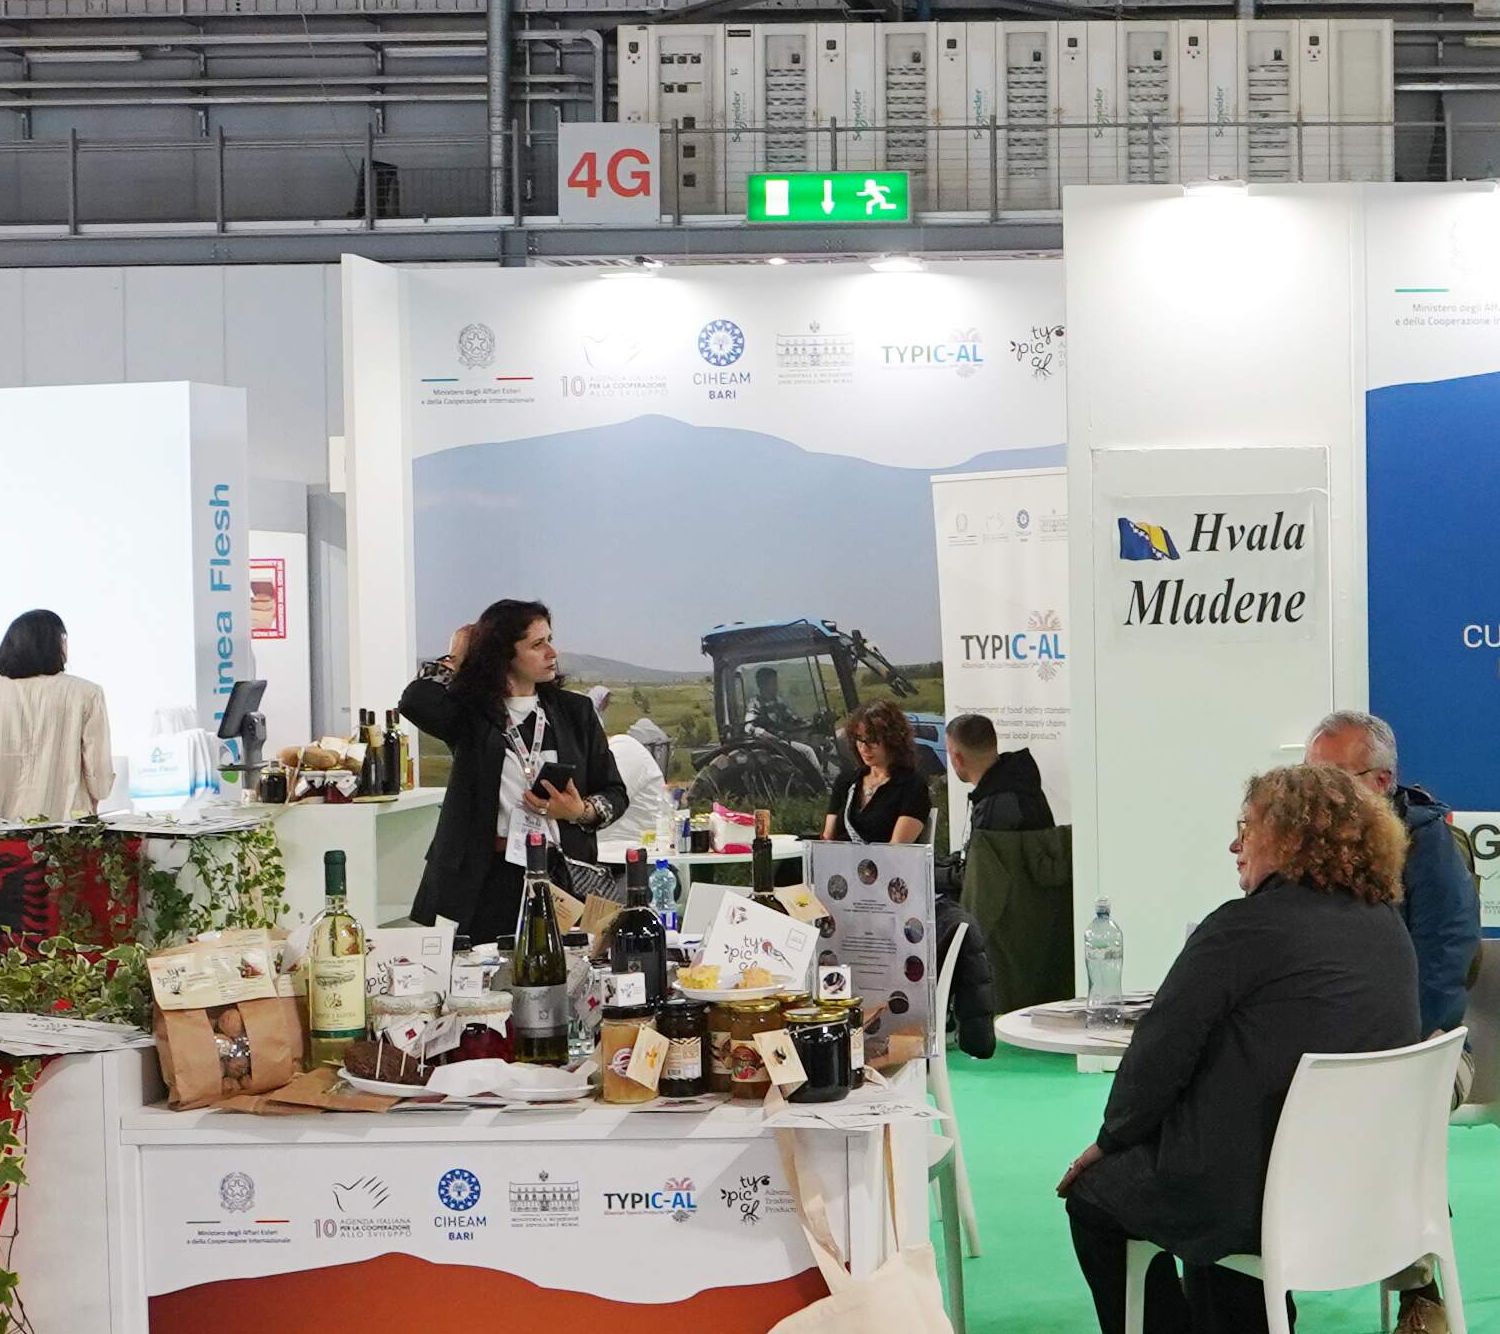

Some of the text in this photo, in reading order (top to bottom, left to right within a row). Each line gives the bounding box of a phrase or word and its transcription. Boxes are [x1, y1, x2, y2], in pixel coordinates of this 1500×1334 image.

[566, 147, 652, 199] 4G
[881, 343, 984, 365] TYPIC-AL
[561, 375, 586, 397] 10
[692, 371, 751, 385] CIHEAM
[708, 390, 737, 400] BARI
[1186, 510, 1306, 553] Hvala
[209, 483, 234, 721] inea Flesh
[1123, 577, 1306, 627] Mladene
[960, 633, 1066, 660] TYPIC-AL
[603, 1191, 698, 1210] TYPIC-AL
[313, 1217, 338, 1239] 10
[434, 1216, 487, 1228] CIHEAM
[448, 1232, 474, 1241] BARI
